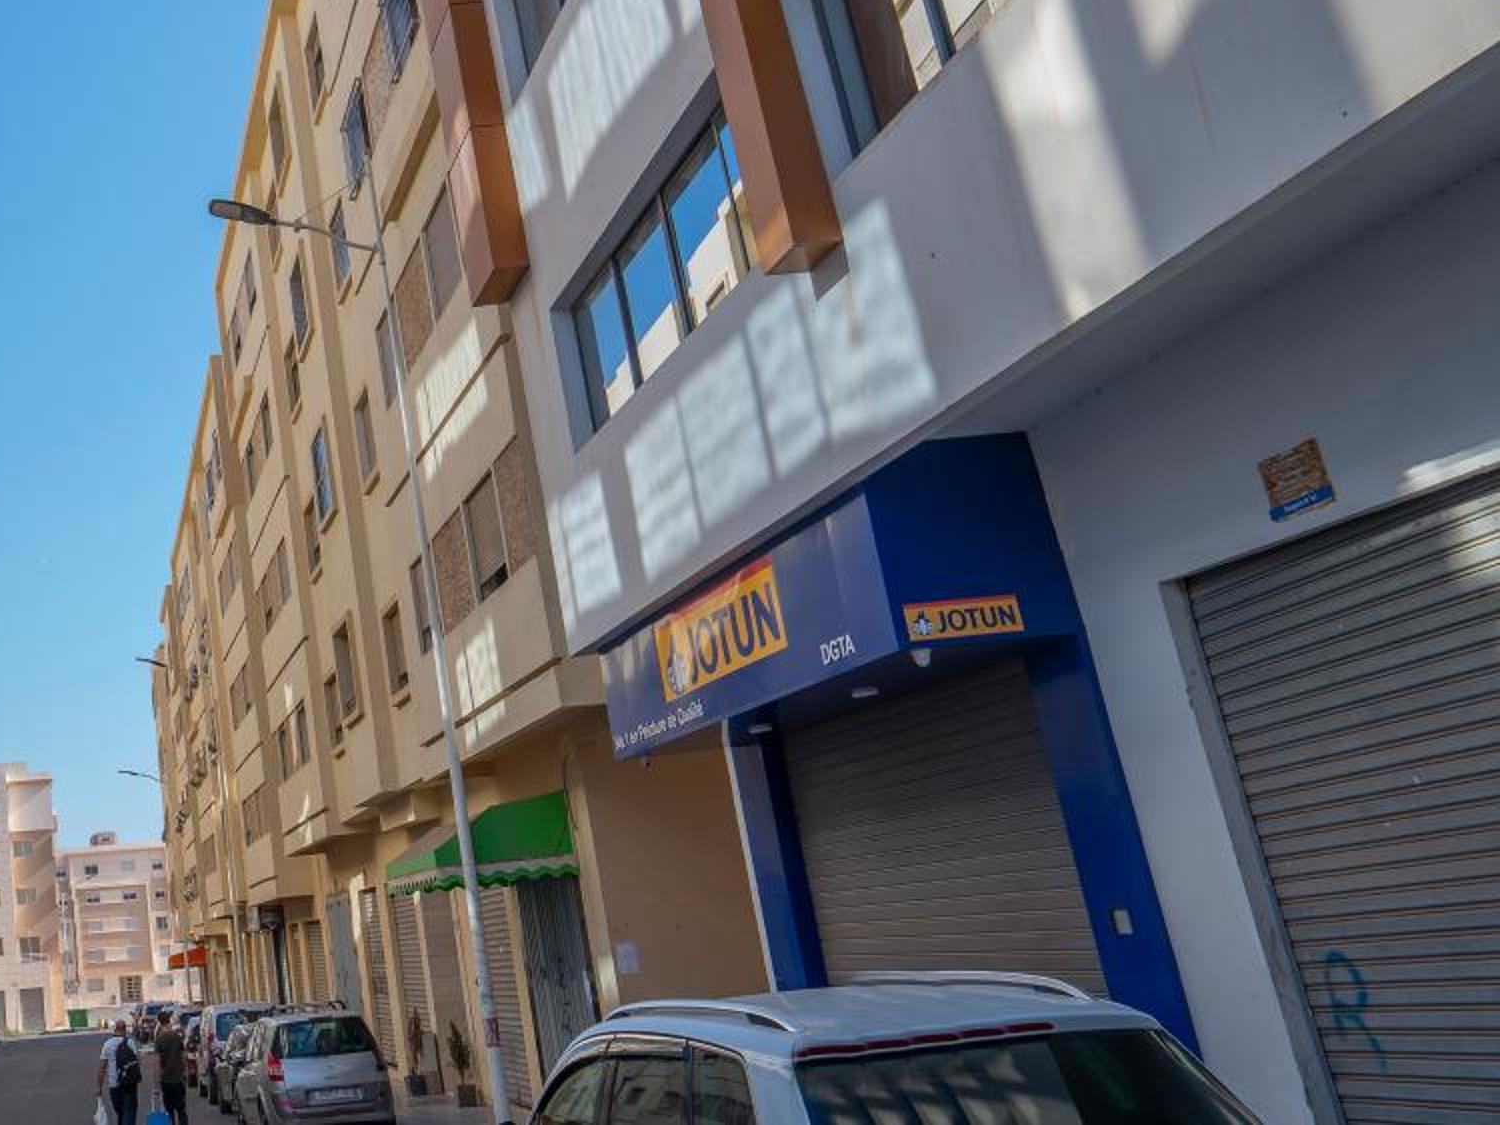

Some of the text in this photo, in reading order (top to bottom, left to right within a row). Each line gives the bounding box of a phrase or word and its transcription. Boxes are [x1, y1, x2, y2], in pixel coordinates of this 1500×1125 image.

[686, 581, 781, 685] JOTUN
[938, 604, 1017, 633] JOTUN
[820, 634, 856, 665] DGTA
